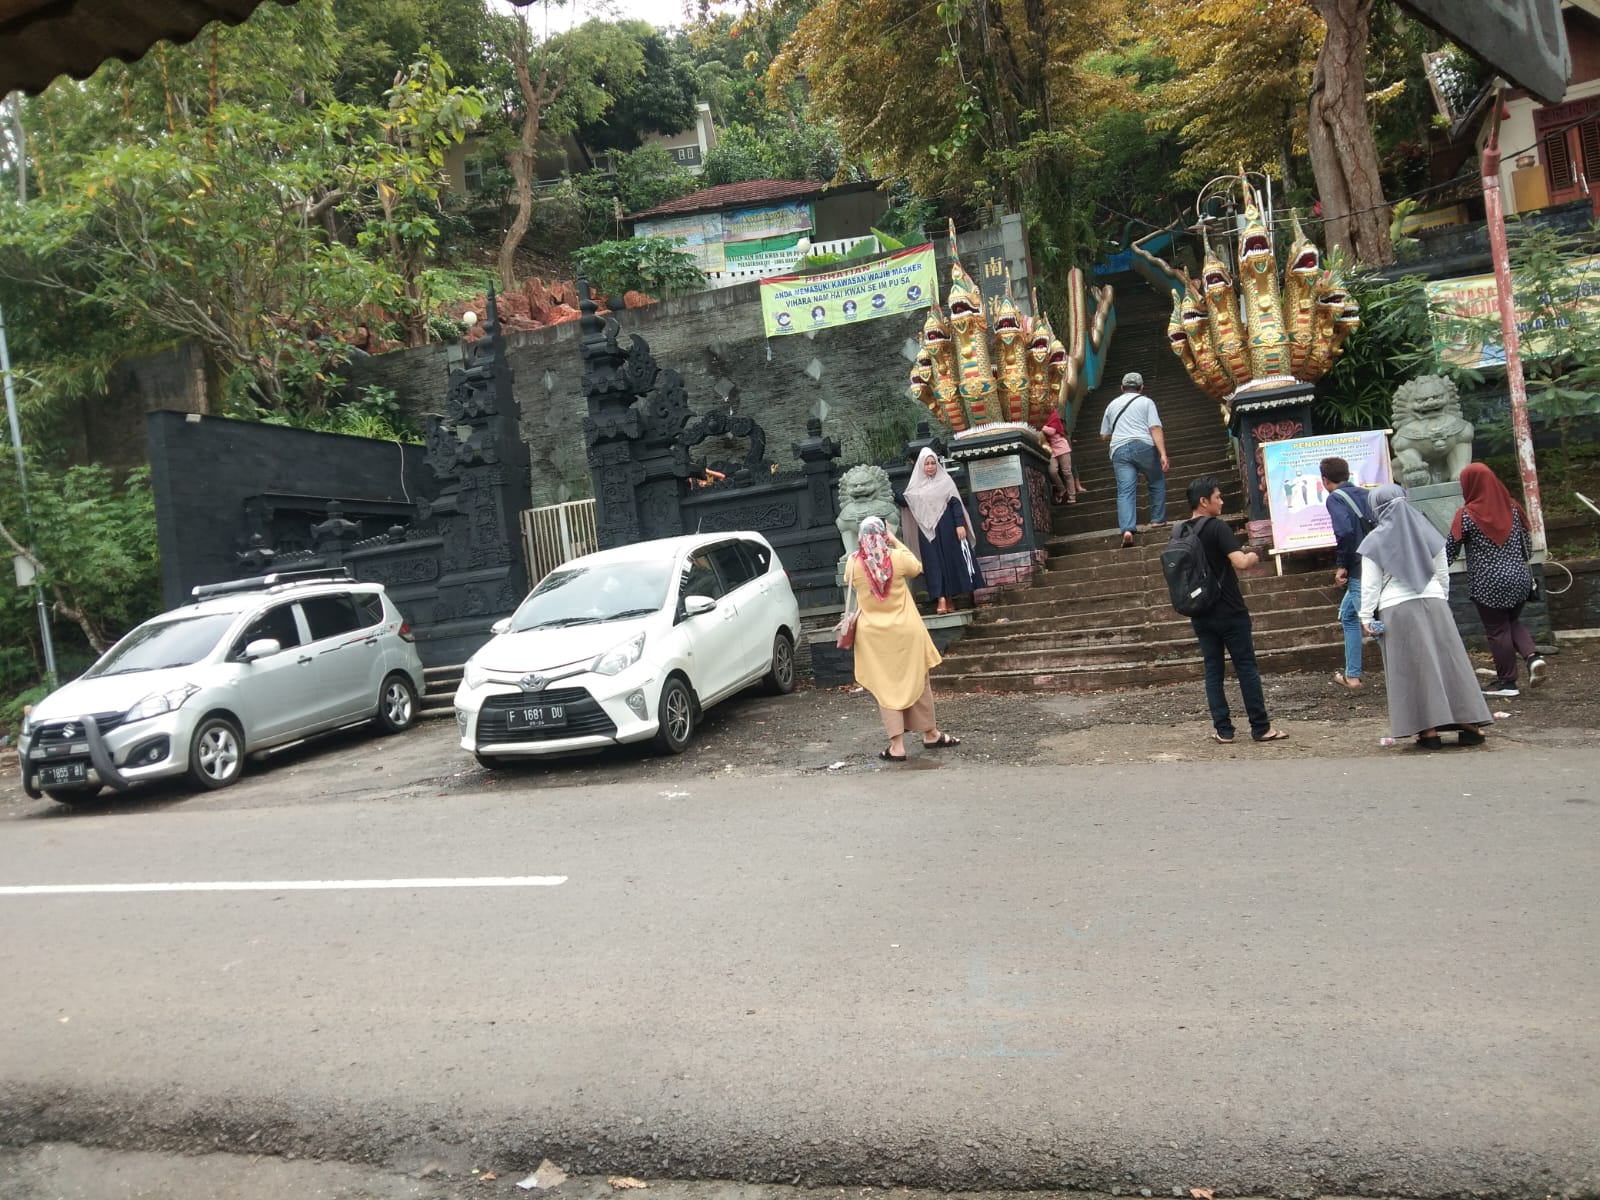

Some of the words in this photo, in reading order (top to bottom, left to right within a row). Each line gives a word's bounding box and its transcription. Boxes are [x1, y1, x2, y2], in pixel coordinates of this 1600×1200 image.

[774, 290, 794, 300] ANDA
[793, 282, 831, 297] MEMASUKI
[831, 275, 867, 290] KAWASAN
[868, 270, 891, 281] WAJIB
[892, 263, 923, 276] MASKER
[785, 296, 812, 308] VIHARA
[813, 293, 829, 303] NAM
[830, 291, 844, 299] HAI
[844, 284, 867, 298] KWAN
[867, 282, 878, 291] SE
[878, 280, 888, 290] IM
[889, 278, 900, 287] PU
[900, 276, 911, 285] SA
[1293, 436, 1361, 449] PENGUMUMAN
[509, 710, 516, 723] F
[523, 708, 544, 721] 1681
[551, 706, 563, 719] DU
[40, 770, 45, 780] F
